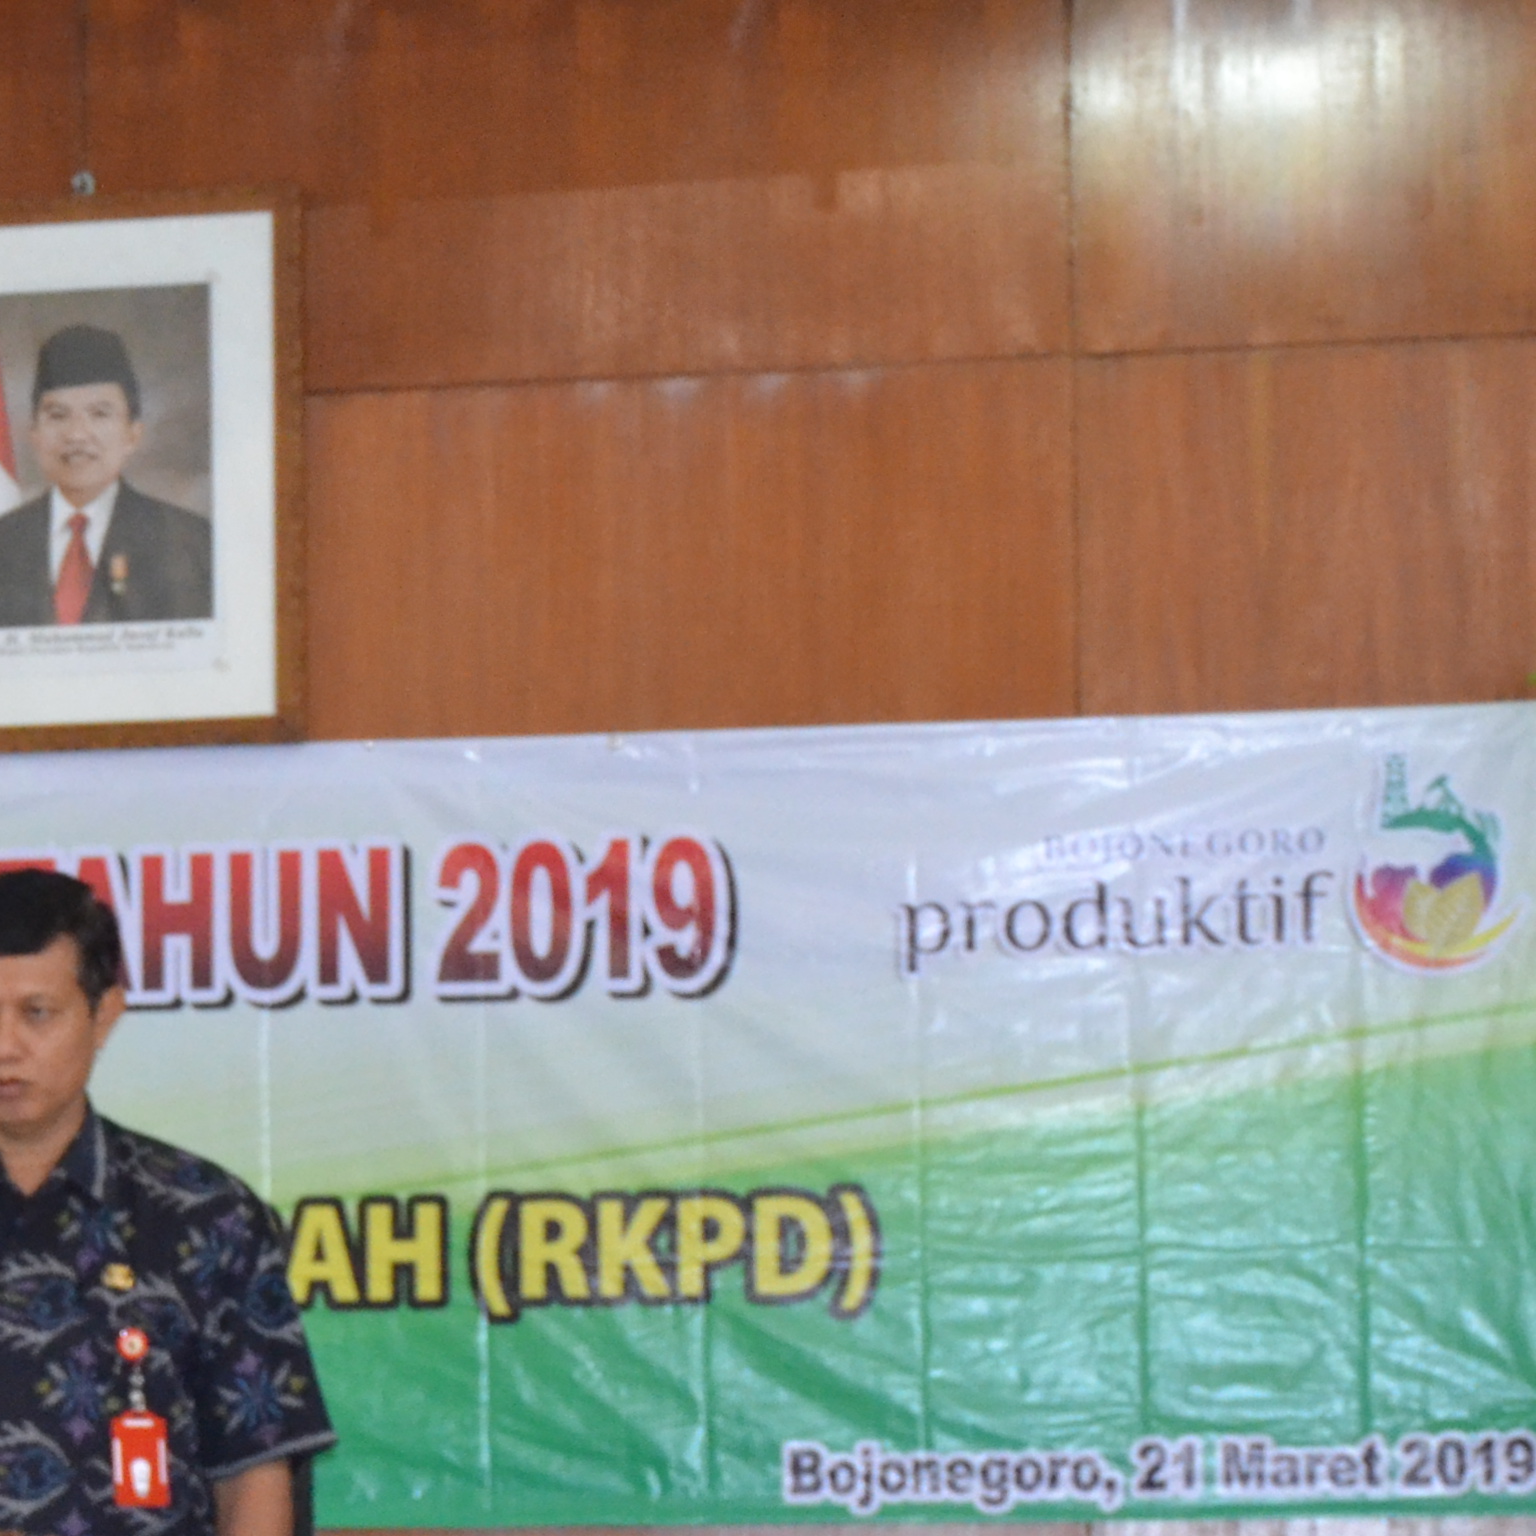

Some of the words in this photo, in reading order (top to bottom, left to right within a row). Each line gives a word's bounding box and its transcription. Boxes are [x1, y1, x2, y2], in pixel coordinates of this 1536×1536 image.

[436, 834, 718, 987] 2019
[899, 869, 1335, 973] produktif
[473, 1188, 875, 1318] (RKPD)
[787, 1447, 1120, 1508] Bojonegoro,
[1135, 1440, 1199, 1493] 21
[1220, 1437, 1381, 1490] Maret
[1400, 1436, 1535, 1488] 2019
